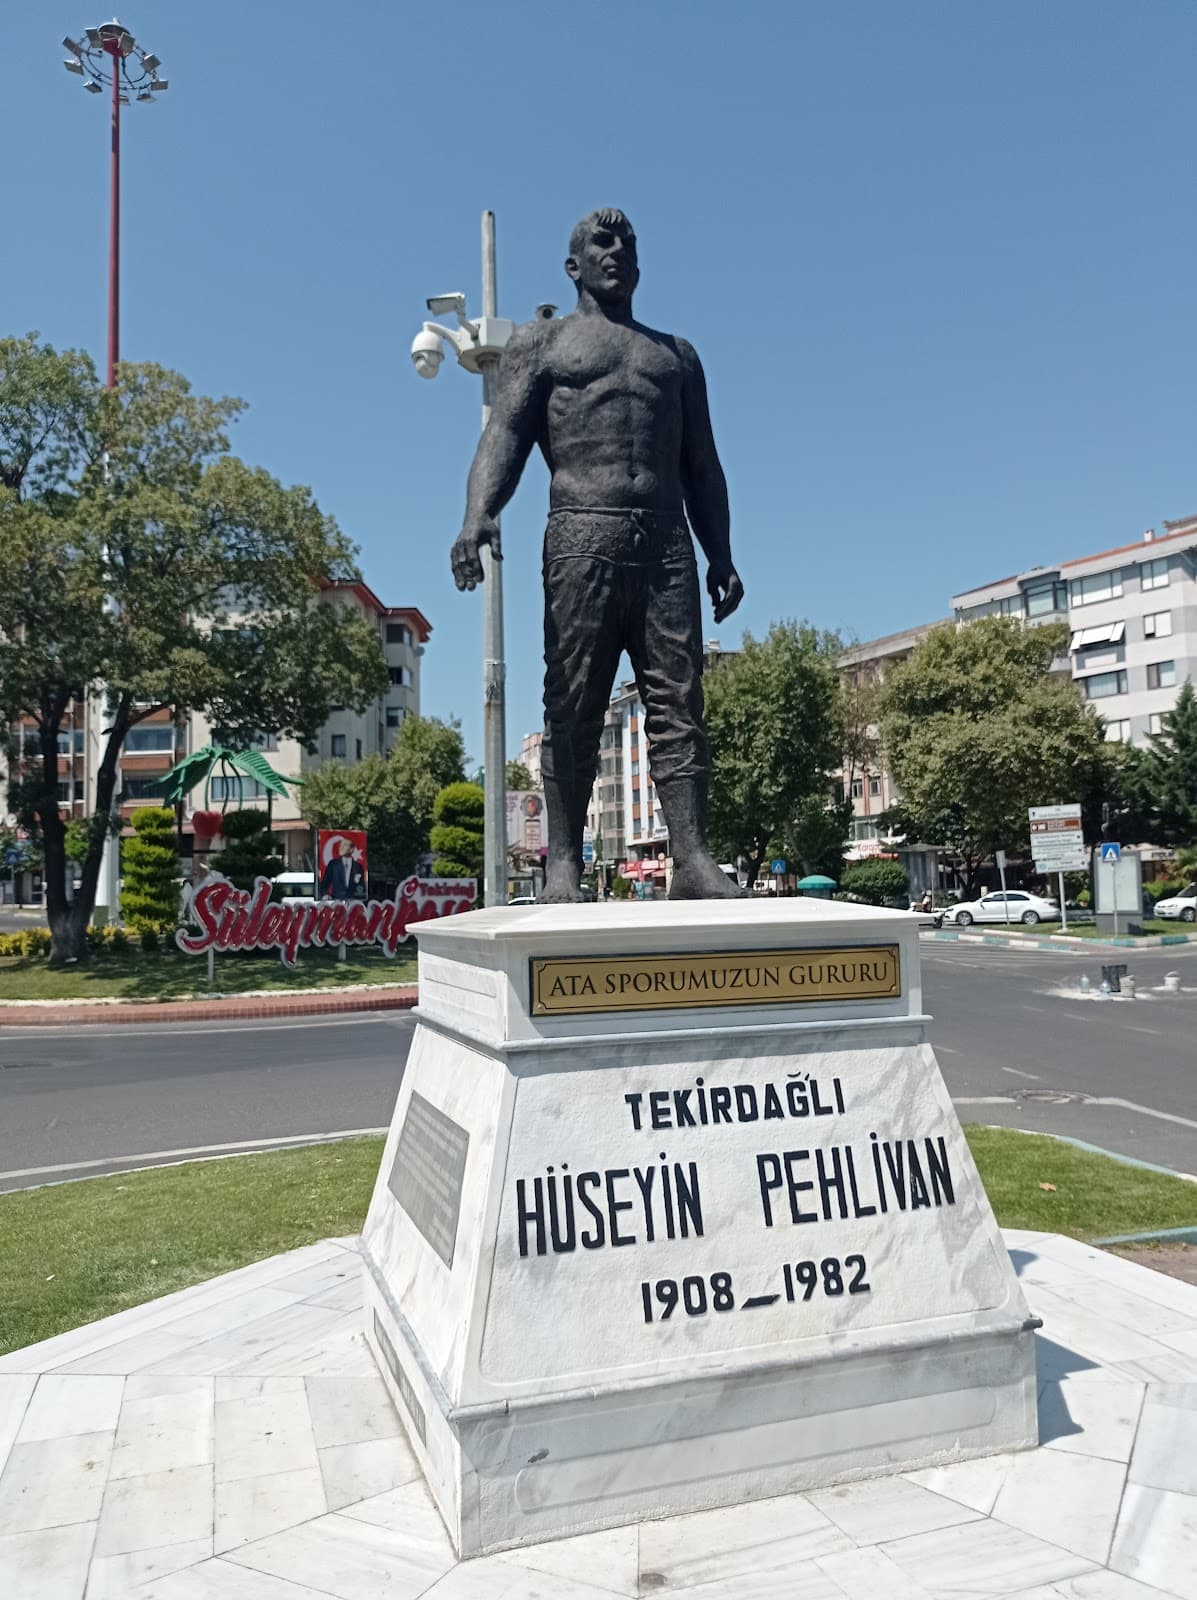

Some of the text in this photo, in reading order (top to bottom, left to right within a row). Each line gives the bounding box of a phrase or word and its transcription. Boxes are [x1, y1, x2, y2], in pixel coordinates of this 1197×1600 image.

[550, 962, 889, 997] ATA SPORUMUZUN GURURU
[516, 1151, 704, 1257] HÜSEYİN
[756, 1132, 956, 1228] PEHLİVAN
